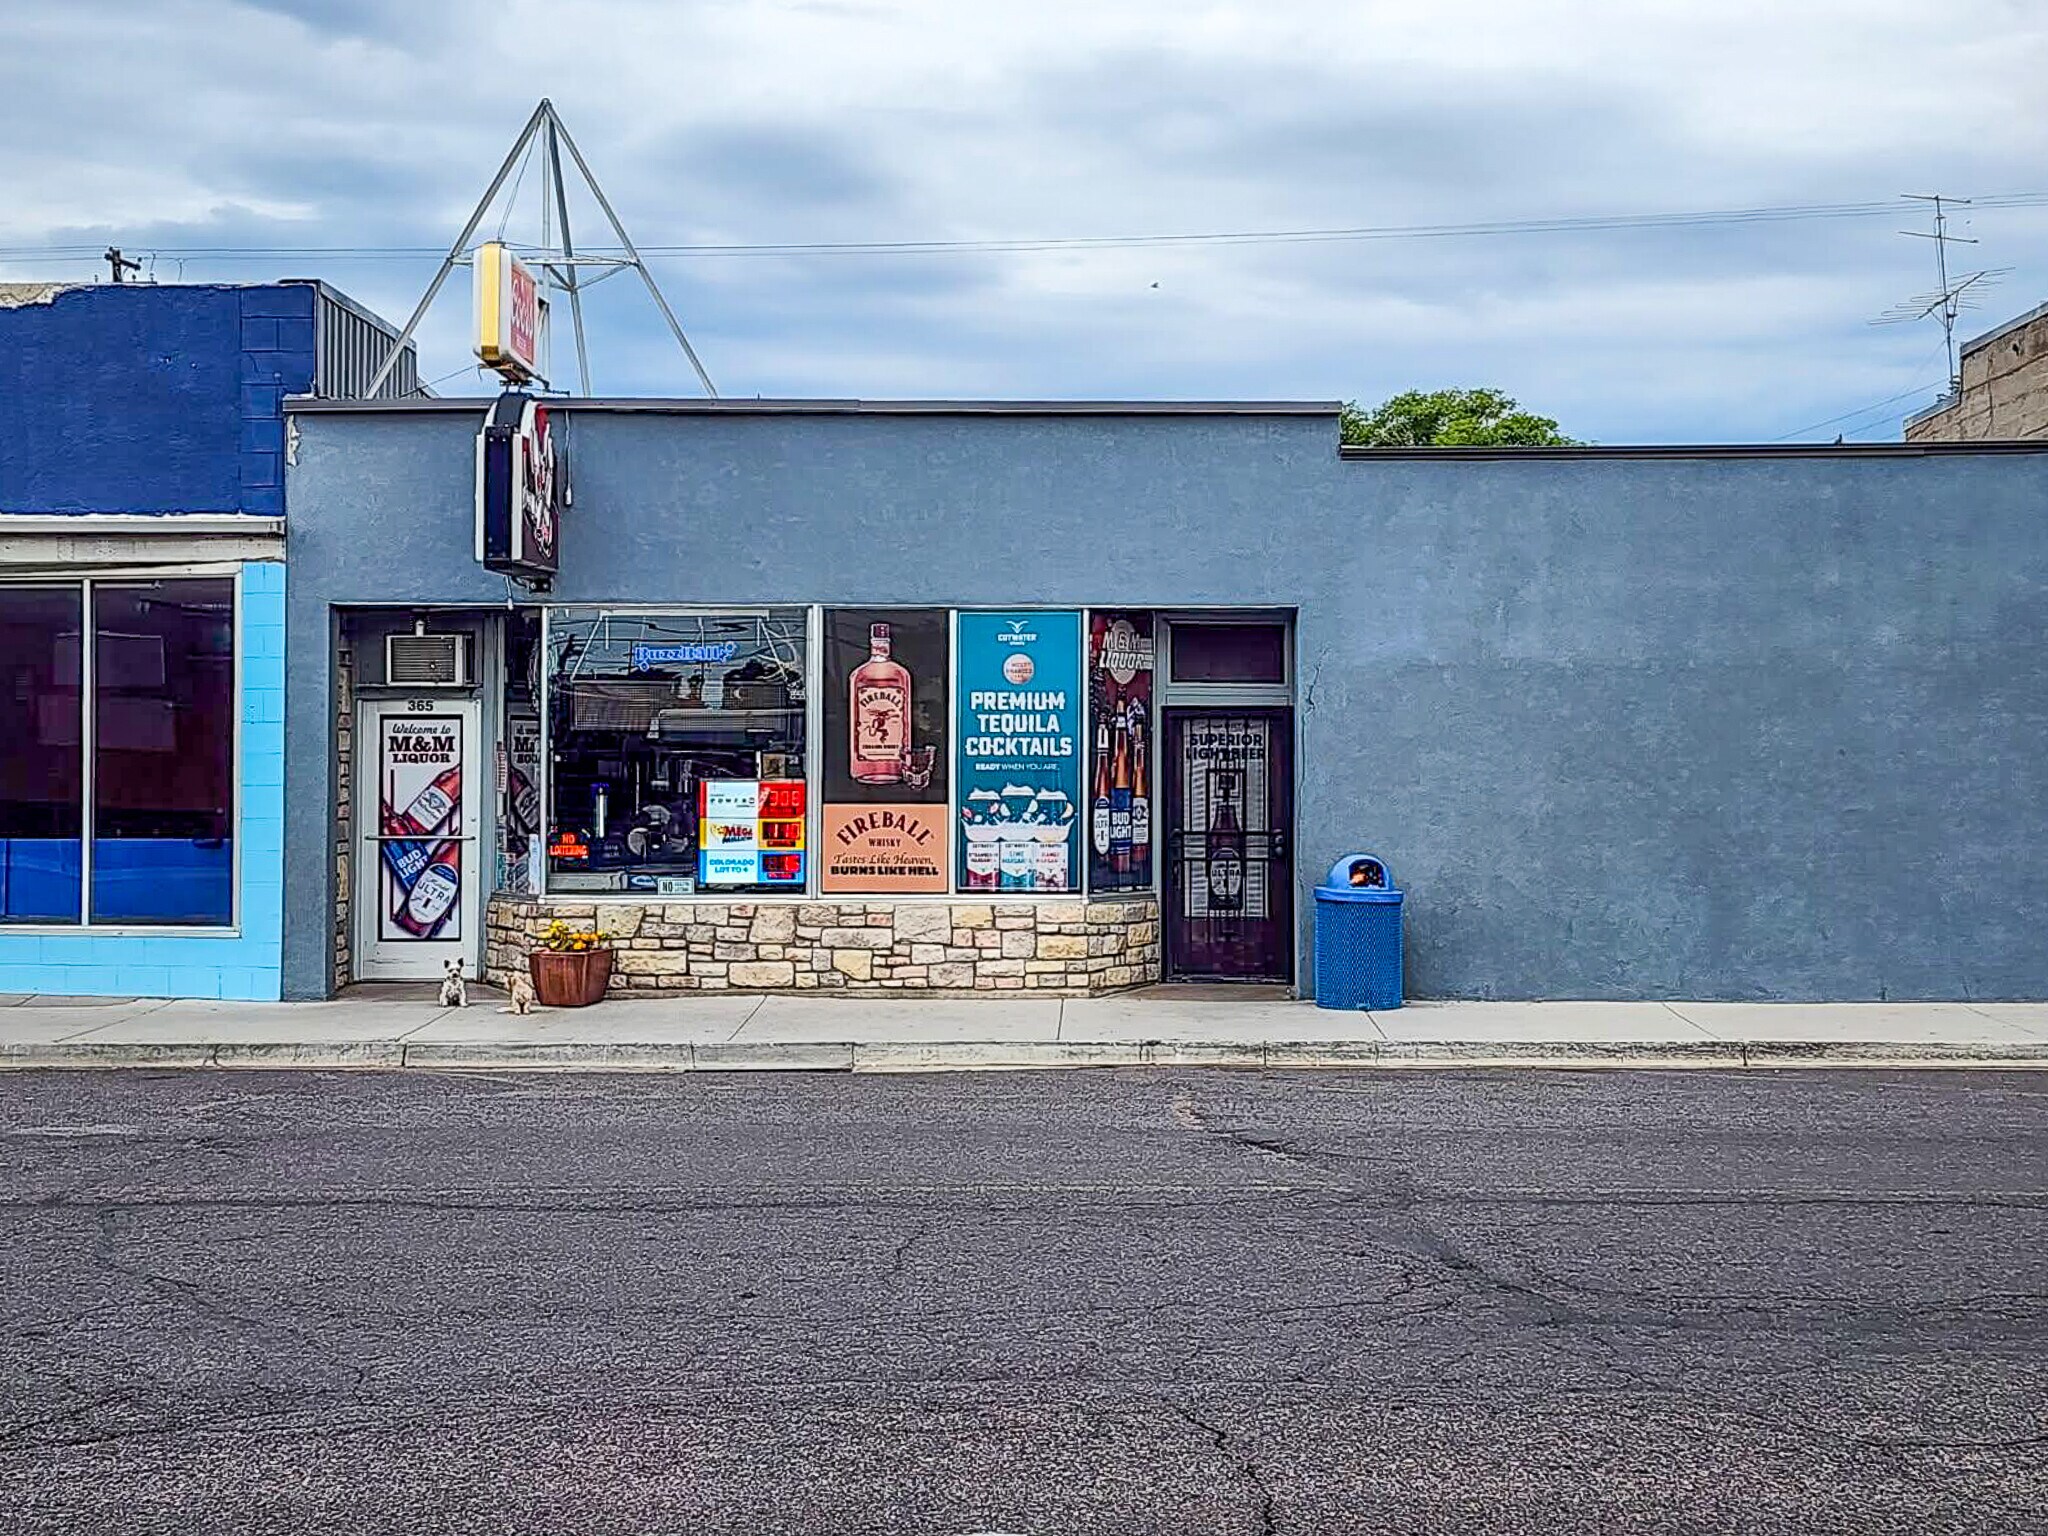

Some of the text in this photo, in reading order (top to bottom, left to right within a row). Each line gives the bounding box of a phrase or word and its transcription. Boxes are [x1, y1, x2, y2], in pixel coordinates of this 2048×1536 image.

[1098, 650, 1144, 672] LIQUOR
[407, 699, 434, 712] 365
[970, 691, 1066, 711] PREMIUM
[392, 723, 451, 734] Welcome to
[977, 714, 1060, 736] TEQUILA
[388, 735, 455, 752] M&M
[965, 736, 1073, 756] COCKTAILS
[1190, 733, 1263, 746] SUPERIOR
[392, 753, 451, 764] LIQUOR
[1112, 812, 1130, 825] BUD
[836, 810, 931, 846] FIREBALL
[1110, 824, 1132, 838] LIGHT
[561, 834, 575, 844] NO
[868, 838, 901, 847] WHISKY
[549, 844, 588, 856] LOITERING
[396, 849, 422, 869] BUD
[709, 858, 755, 866] COLORADO
[833, 853, 866, 865] Tastes
[868, 852, 891, 865] Like
[399, 855, 429, 879] LIGHT
[830, 866, 939, 876] BURNS LIKE HELL
[417, 881, 450, 904] ULTRA
[662, 881, 673, 892] NO
